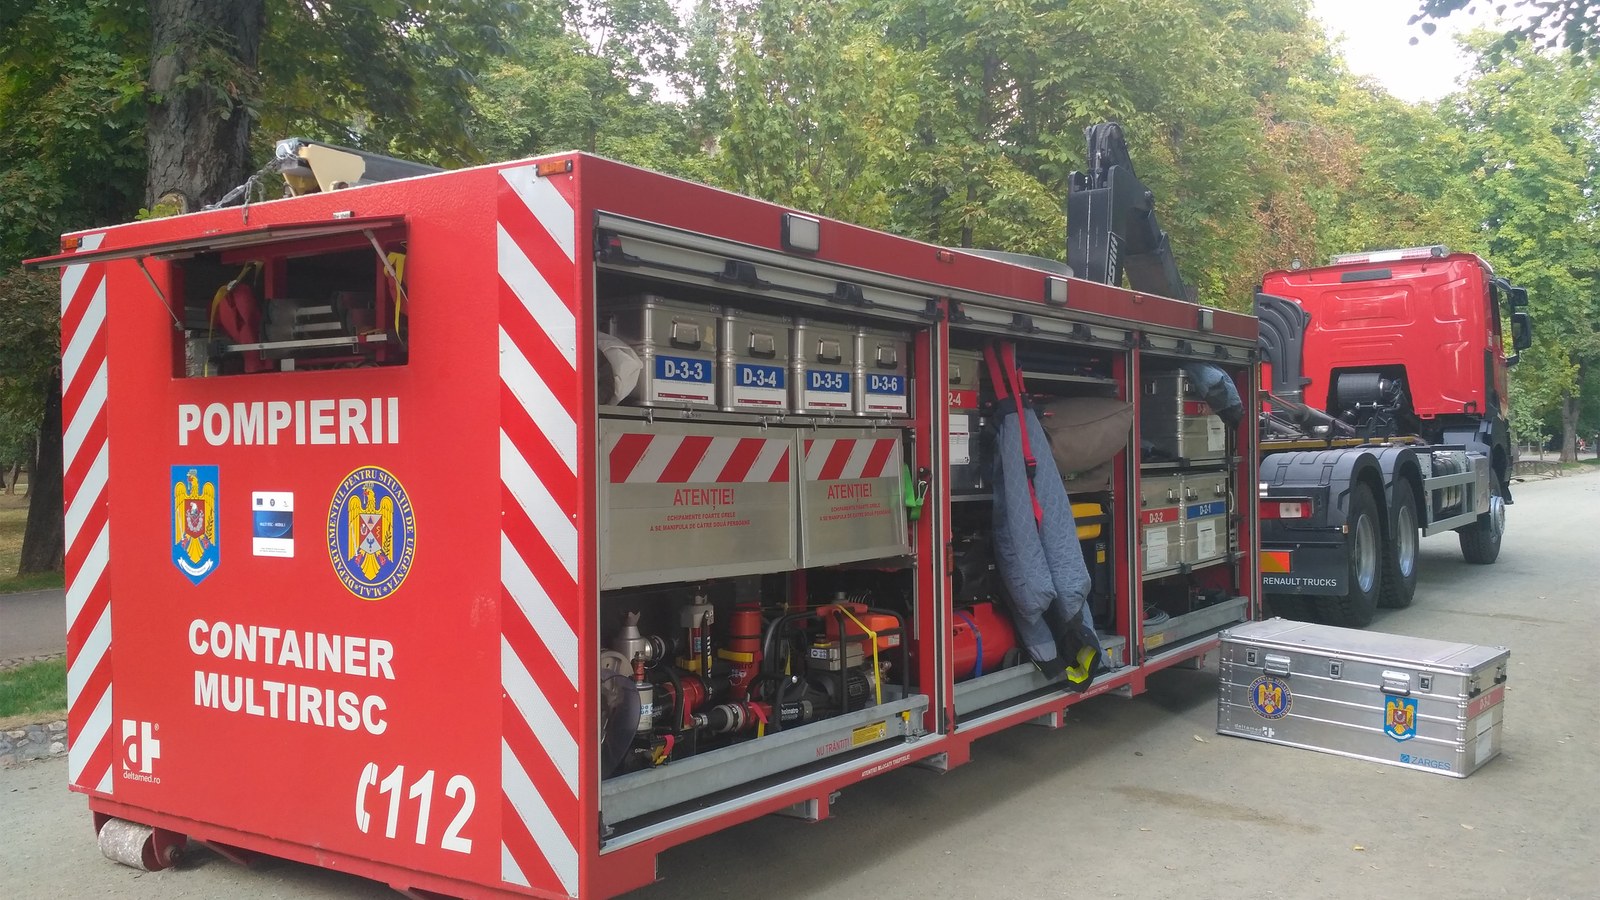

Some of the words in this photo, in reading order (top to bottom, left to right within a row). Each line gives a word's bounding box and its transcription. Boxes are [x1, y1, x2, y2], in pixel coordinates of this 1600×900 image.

[664, 360, 703, 380] D-3-3
[743, 368, 777, 387] D-3-4
[812, 373, 843, 389] D-3-5
[871, 375, 898, 391] D-3-6
[178, 397, 399, 446] POMPIERII
[1149, 512, 1164, 523] D-2-2
[329, 490, 356, 588] DEPARTAMENTUL
[344, 469, 377, 490] PENTRU
[405, 515, 414, 533] DE
[1262, 577, 1301, 585] RENAULT
[1302, 578, 1337, 587] TRUCKS
[188, 619, 396, 680] CONTAINER
[194, 670, 388, 735] MULTIRISC
[816, 745, 825, 757] NU
[1411, 756, 1451, 770] ZARGES
[123, 771, 161, 784] deltamed.ro
[379, 765, 476, 854] 112
